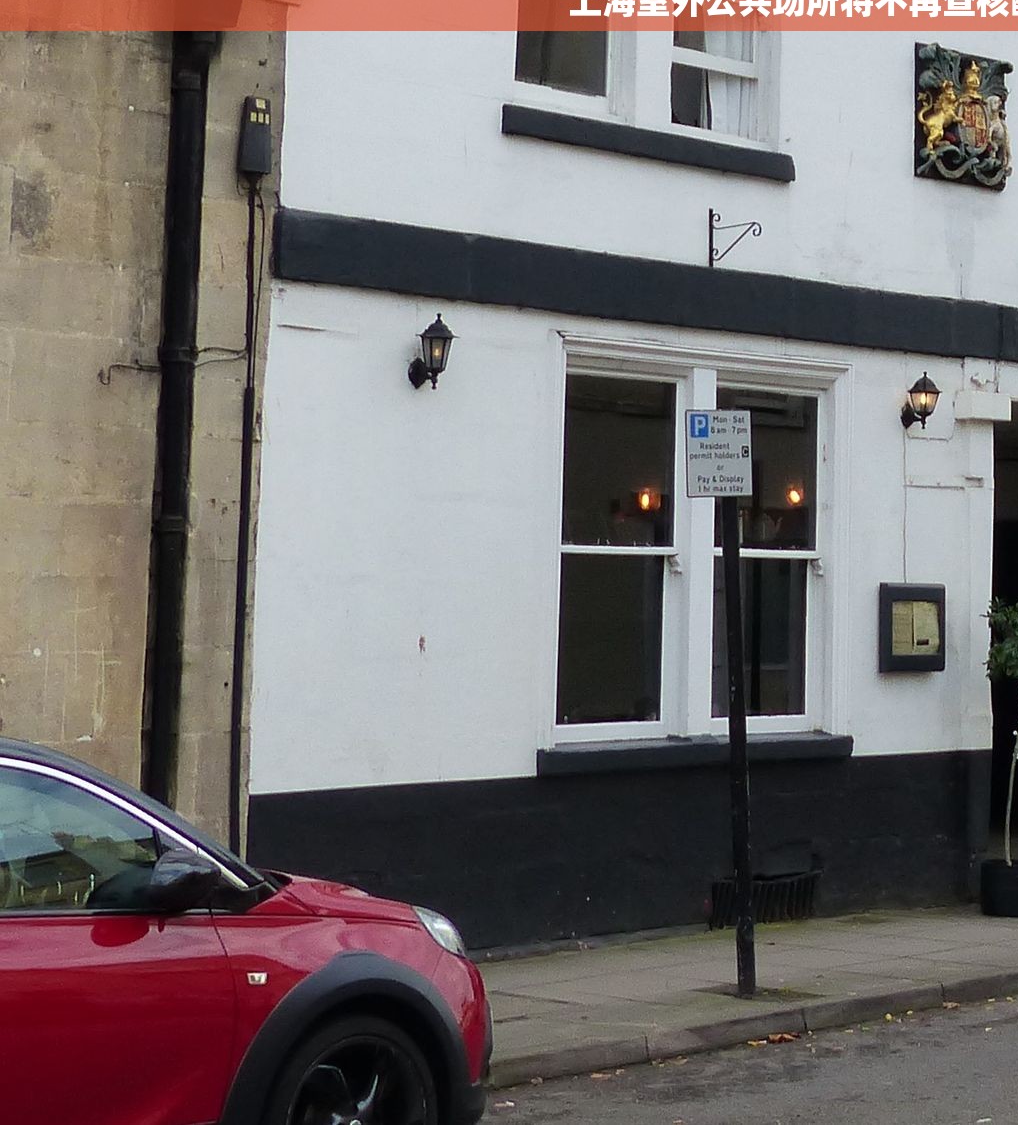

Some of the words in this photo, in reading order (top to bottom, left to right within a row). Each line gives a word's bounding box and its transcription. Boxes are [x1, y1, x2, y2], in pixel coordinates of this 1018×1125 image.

[712, 416, 728, 424] Mon
[732, 415, 745, 424] Sat
[699, 442, 730, 450] Resident
[690, 452, 712, 460] permit
[714, 451, 740, 460] holders
[697, 474, 710, 484] Pay
[719, 474, 744, 484] Display
